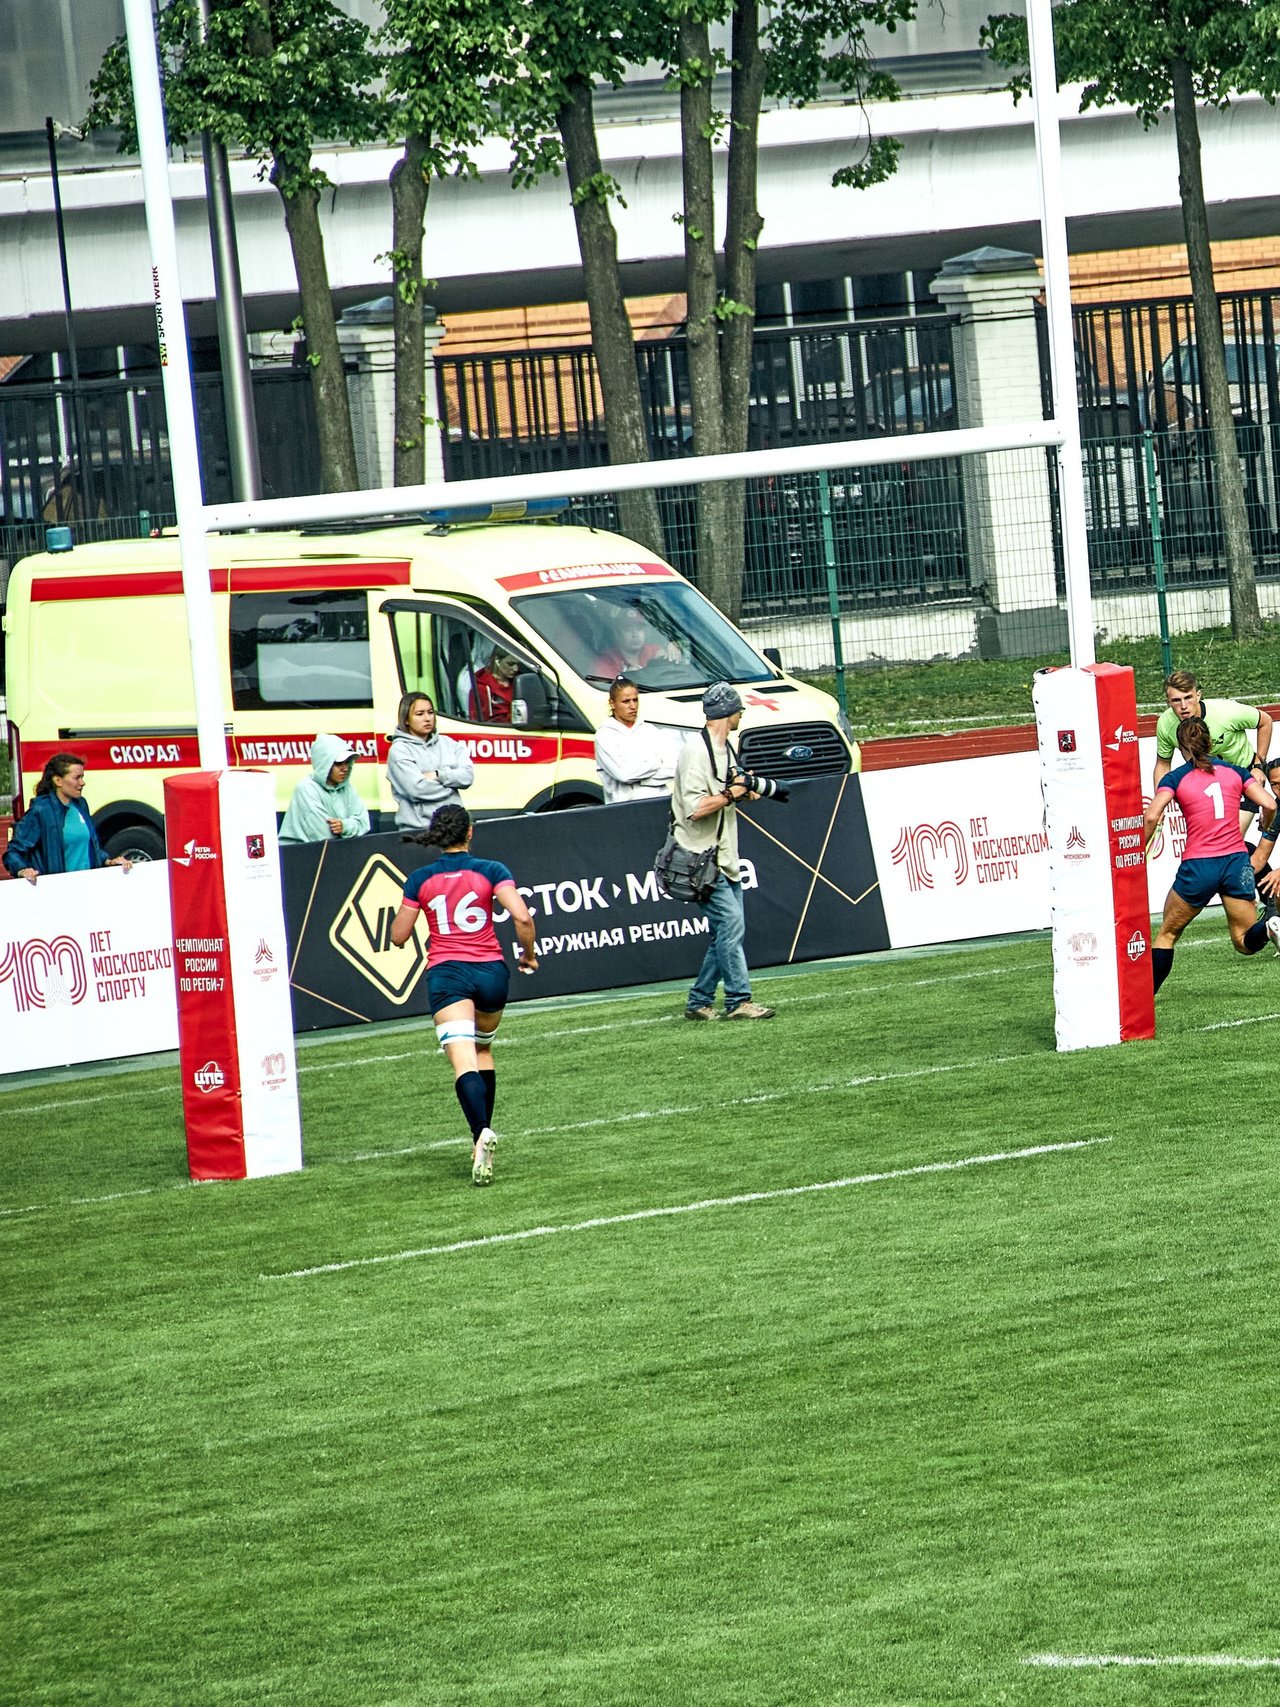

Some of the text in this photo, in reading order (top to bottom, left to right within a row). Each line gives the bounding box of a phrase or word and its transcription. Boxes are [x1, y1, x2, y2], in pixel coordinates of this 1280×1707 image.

[109, 740, 532, 764] СКОРАЯ МЕДИЦАЯ МОЩЬ
[1203, 782, 1225, 819] 1
[970, 816, 988, 838] ЛЕТ
[1111, 815, 1144, 832] ЧЕМПИОНАТ
[972, 832, 1049, 860] МОСКОВСКОМ
[1118, 834, 1140, 850] РОССИИ
[976, 860, 1018, 884] СПОРТУ
[1115, 855, 1124, 869] ПО
[427, 890, 487, 935] 16
[89, 930, 112, 953] ЛЕТ
[628, 916, 710, 944] РЕКЛАМ
[175, 938, 224, 953] ЧЕМПИОНАТ
[92, 947, 173, 978] МОСКОВСКО
[185, 958, 218, 972] РОССИИ
[96, 976, 146, 1003] СПОРТУ
[180, 977, 225, 992] ПО РЕГБИ-7
